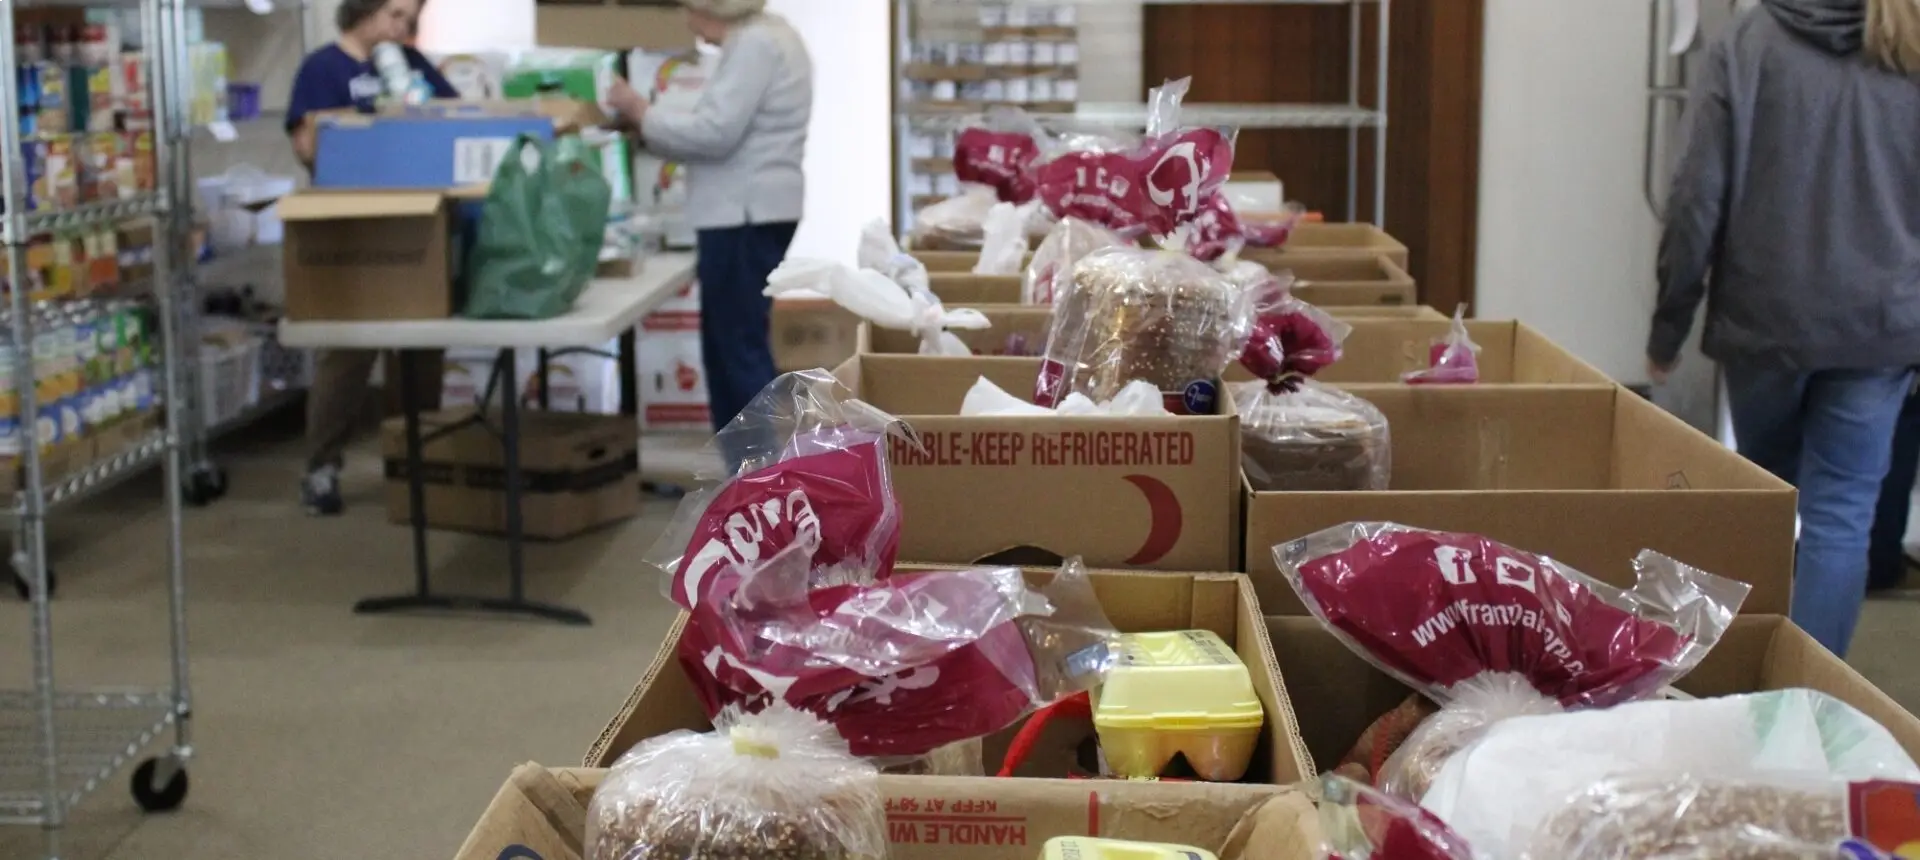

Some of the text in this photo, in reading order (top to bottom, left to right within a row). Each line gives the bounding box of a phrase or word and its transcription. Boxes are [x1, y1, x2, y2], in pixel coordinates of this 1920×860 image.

[888, 431, 1194, 465] HABLE-KEEP REFRIGERATED
[924, 797, 945, 813] AT
[924, 823, 1027, 846] HANDLE
